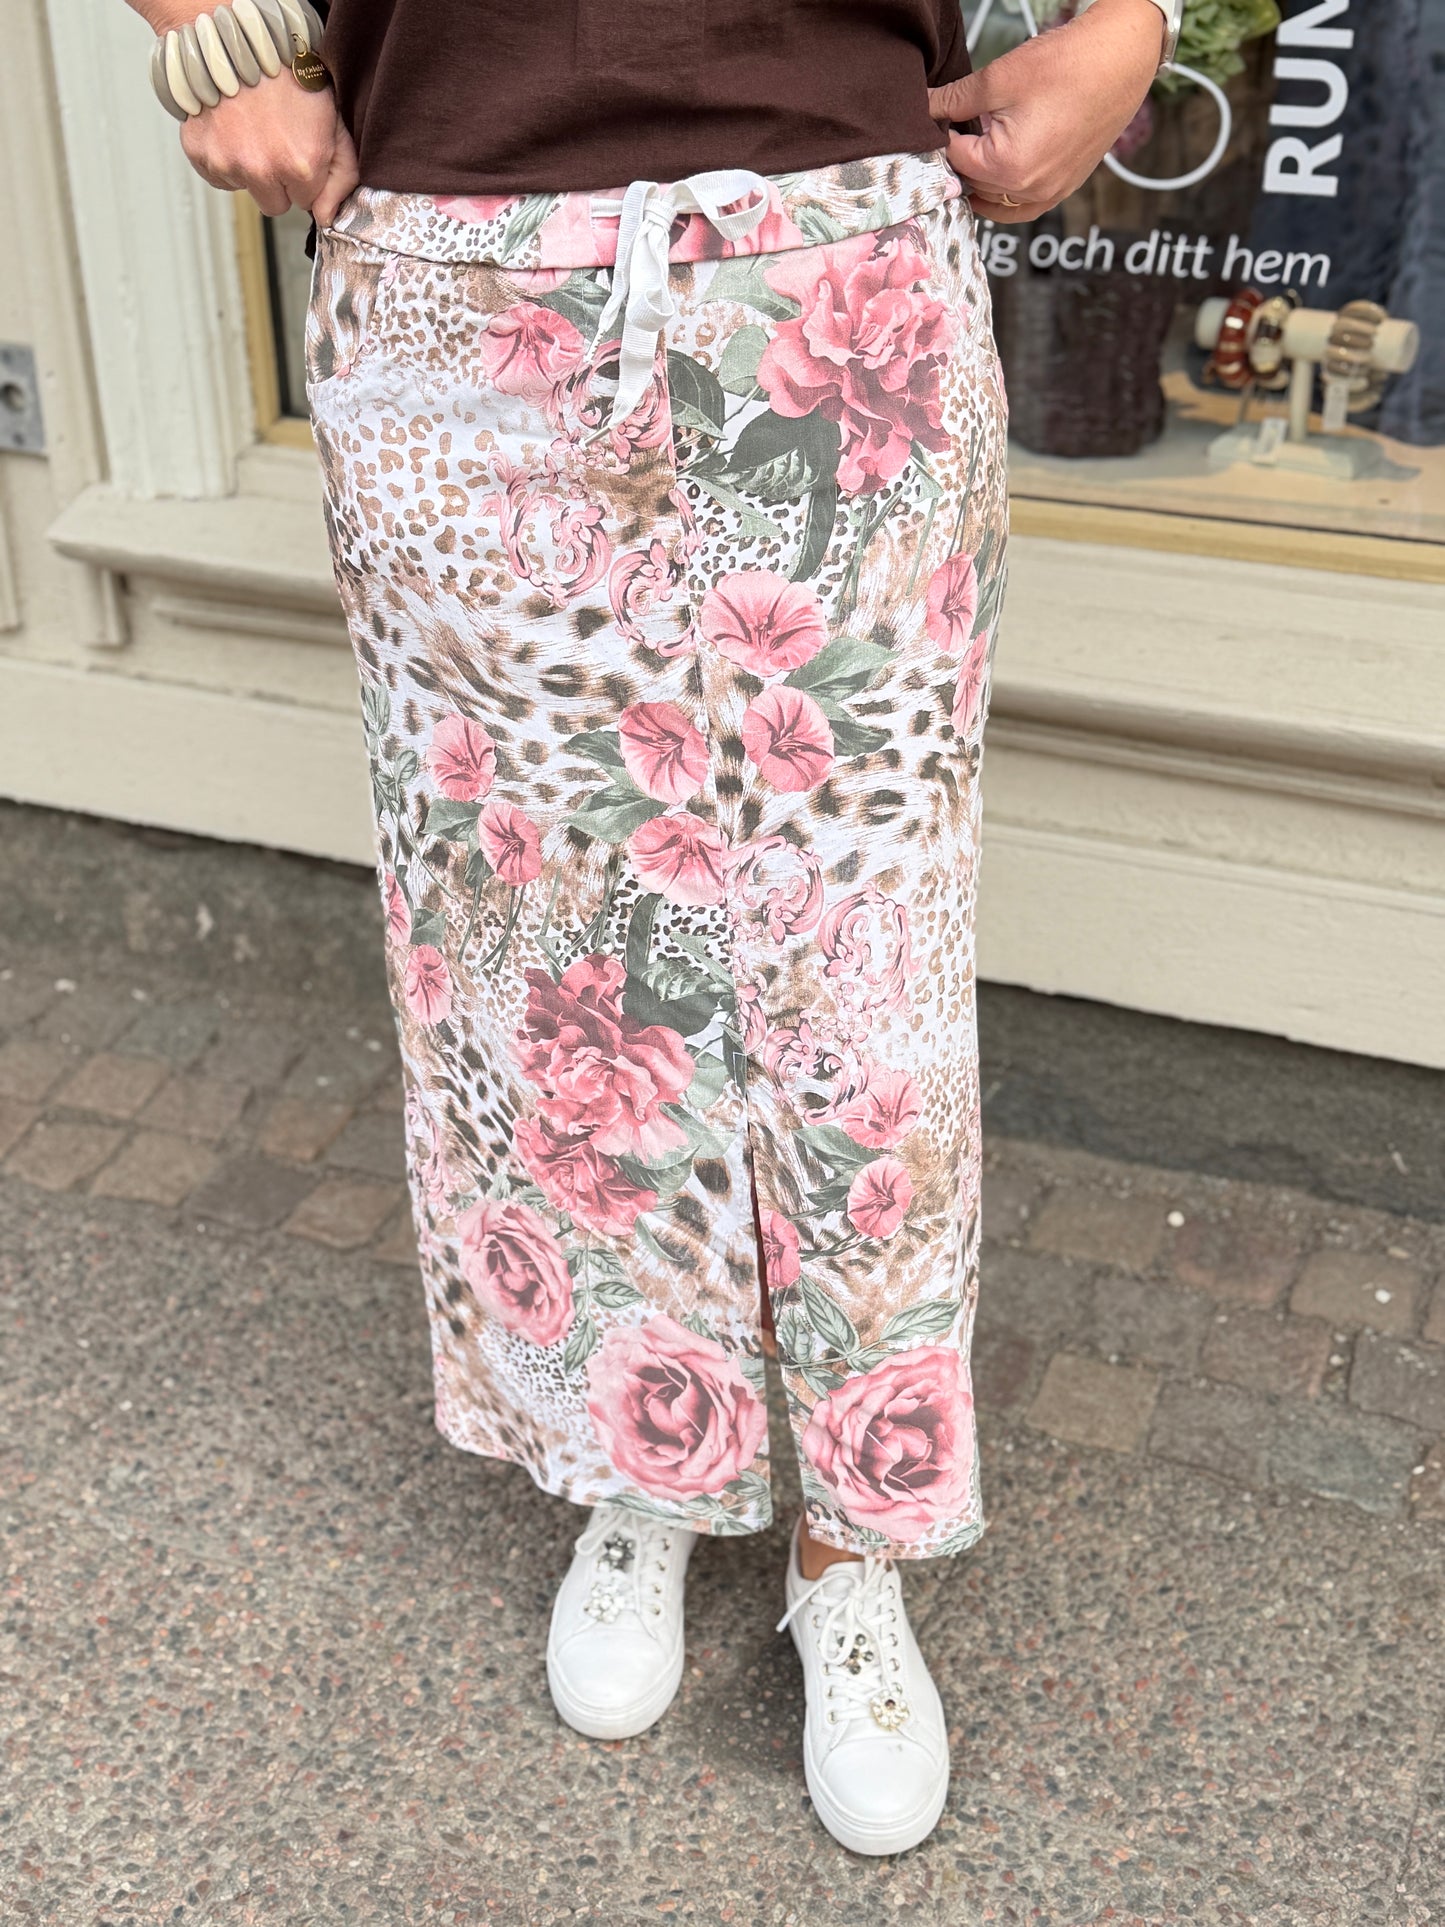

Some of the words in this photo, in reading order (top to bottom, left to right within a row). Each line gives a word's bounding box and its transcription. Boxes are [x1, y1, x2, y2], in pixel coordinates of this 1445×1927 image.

[974, 219, 1019, 277] ig
[1028, 224, 1115, 272] och
[1124, 228, 1214, 280] ditt
[1220, 233, 1331, 288] hem
